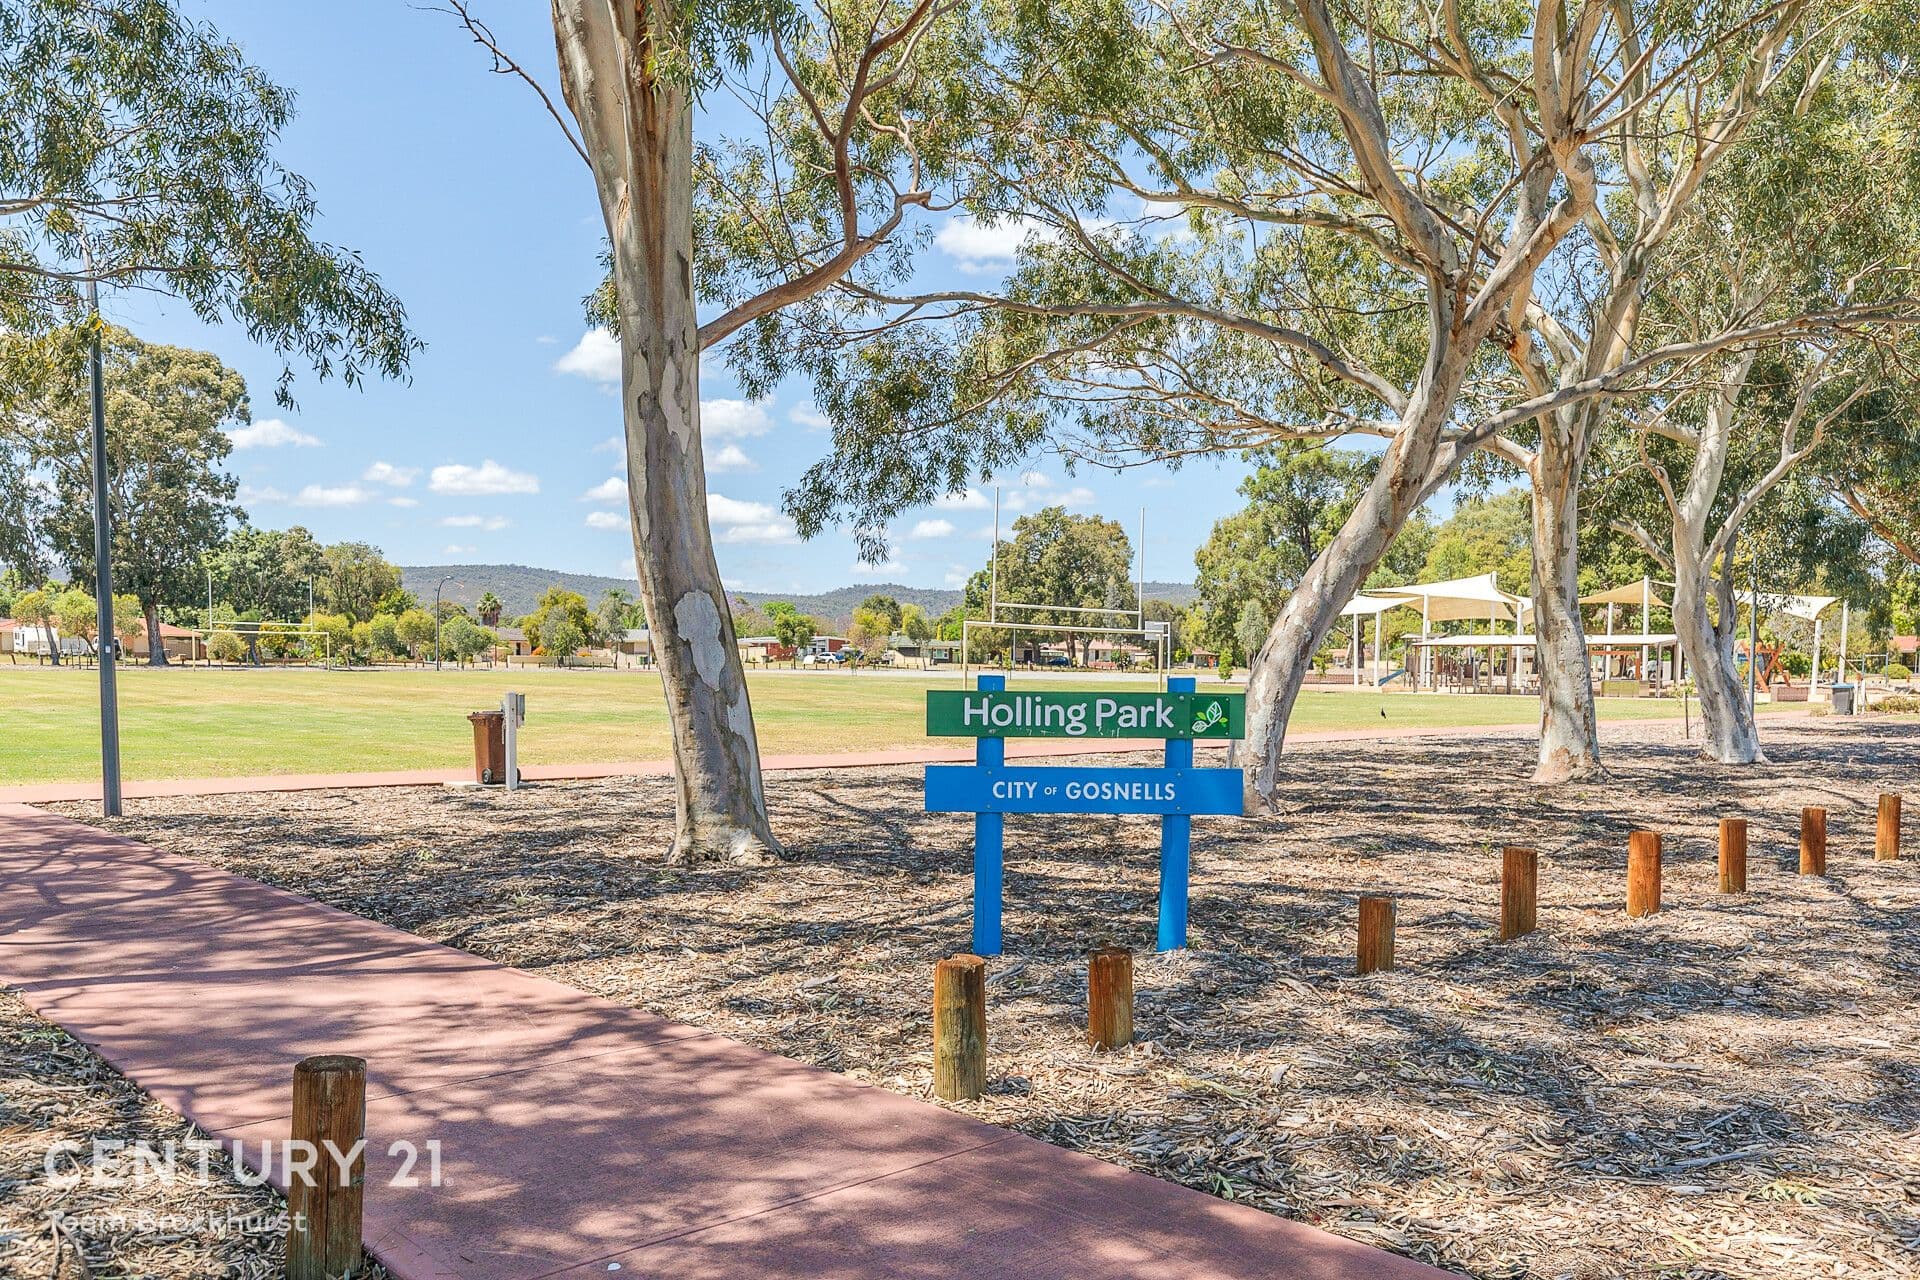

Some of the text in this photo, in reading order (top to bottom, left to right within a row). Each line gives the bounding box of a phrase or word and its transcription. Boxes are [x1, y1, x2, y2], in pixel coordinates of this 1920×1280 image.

[963, 696, 1175, 735] Holling Park
[992, 781, 1038, 799] CITY
[1065, 782, 1176, 801] GOSNELLS
